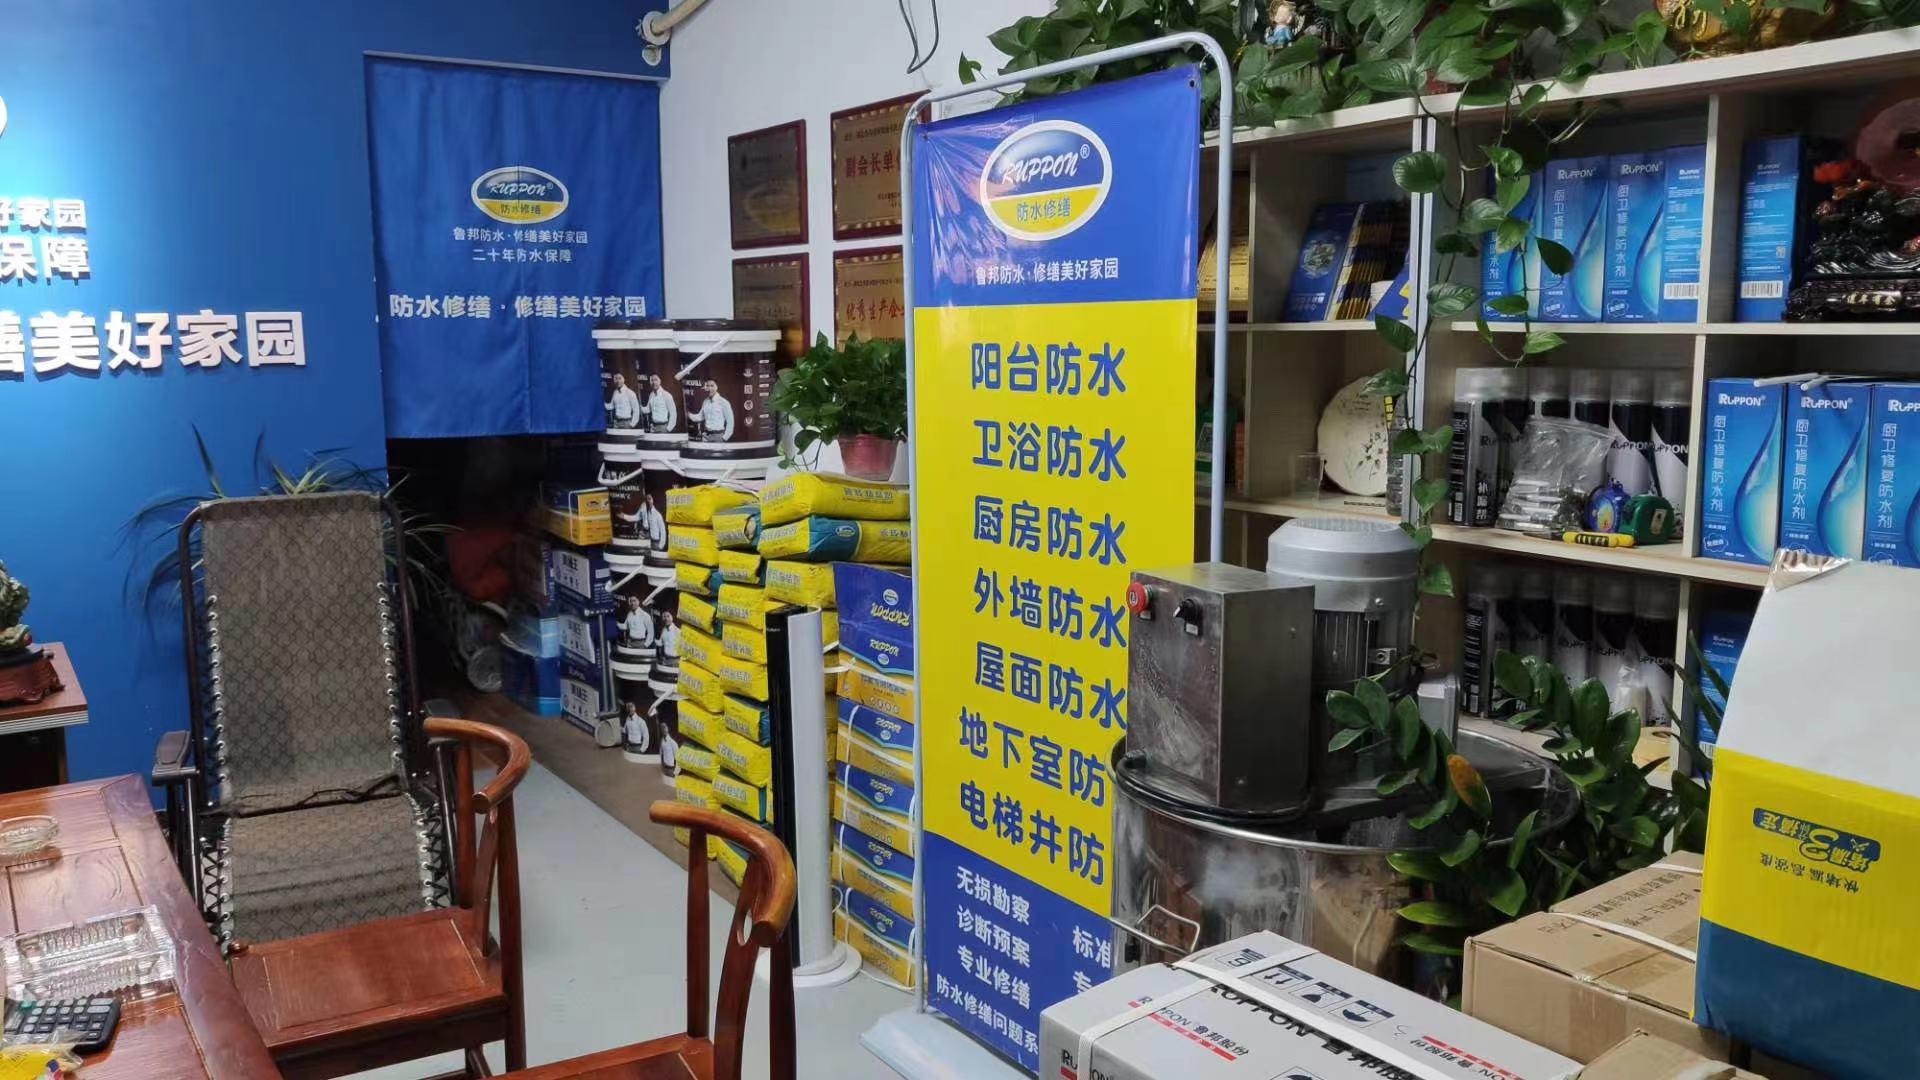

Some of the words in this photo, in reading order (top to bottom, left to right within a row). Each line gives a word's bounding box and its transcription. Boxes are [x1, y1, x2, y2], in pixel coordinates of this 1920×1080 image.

[1016, 197, 1071, 223] 防水修缮
[472, 248, 573, 264] 二十年防水保障
[971, 341, 1127, 397] 阳台防水
[1718, 393, 1762, 407] RUPPON
[1801, 396, 1848, 410] RUPPON
[972, 419, 1127, 482] 卫浴防水
[1710, 414, 1727, 512] 厨卫修复防水剂
[1791, 418, 1809, 520] 厨卫修复防水剂
[1877, 422, 1897, 529] 厨卫修复防水剂
[973, 494, 1127, 566] 厨房防水
[974, 567, 1128, 649] 外墙防水
[975, 641, 1128, 731] 屋面防水
[958, 705, 1106, 808] 地下室防
[960, 779, 1105, 886] 电梯井防
[956, 865, 1031, 926] 无损勘察
[956, 903, 1031, 969] 诊断预案
[956, 944, 1031, 1010] 专业修缮
[936, 972, 1039, 1056] 防水修缮问题系
